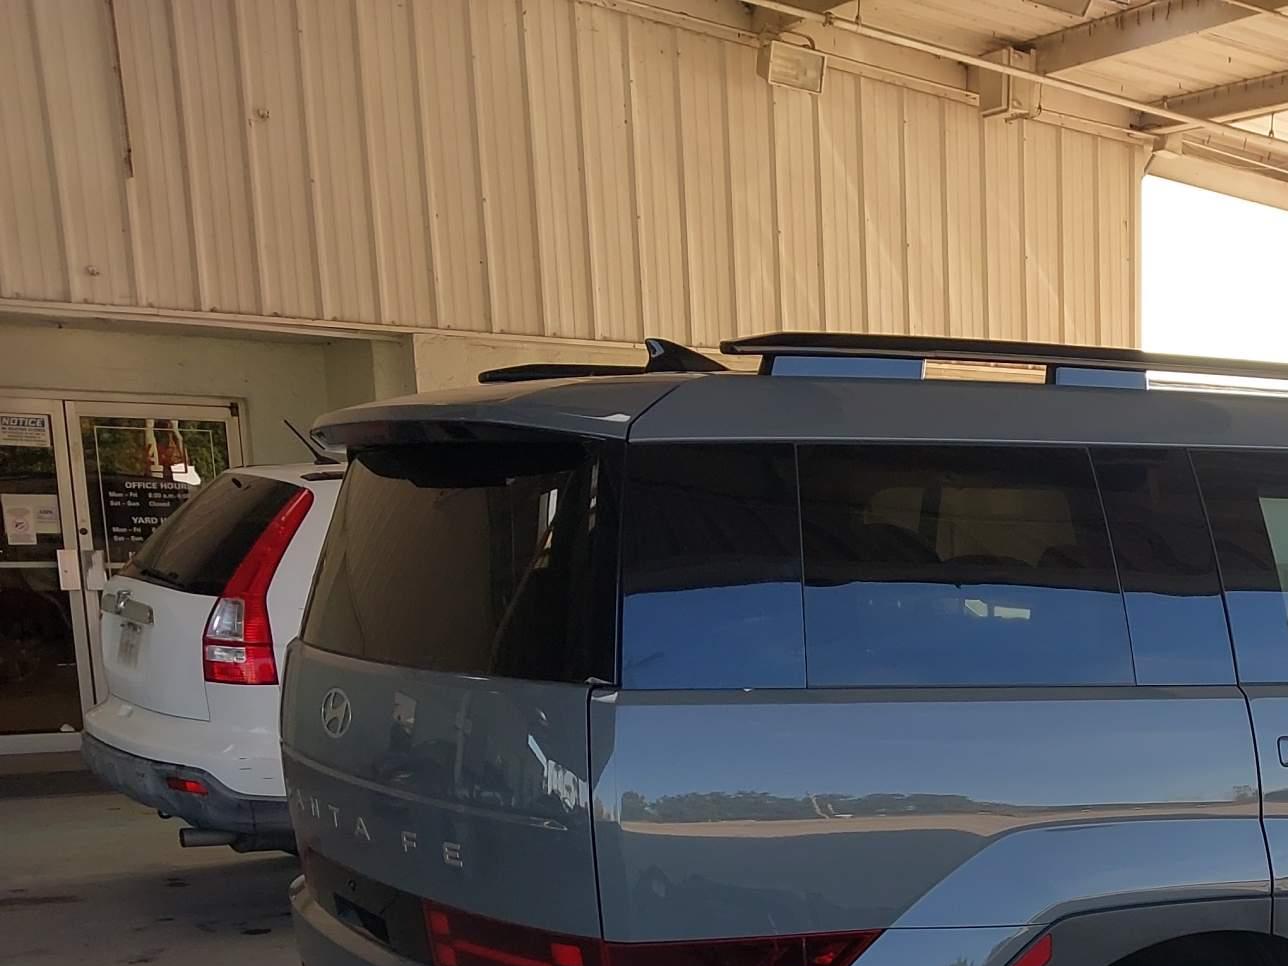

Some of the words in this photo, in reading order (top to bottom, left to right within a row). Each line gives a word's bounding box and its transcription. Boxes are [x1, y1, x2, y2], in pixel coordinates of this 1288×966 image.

[1, 416, 44, 428] NOTICE
[125, 481, 158, 490] OFFICE
[131, 516, 159, 525] YARD
[401, 830, 464, 868] FE
